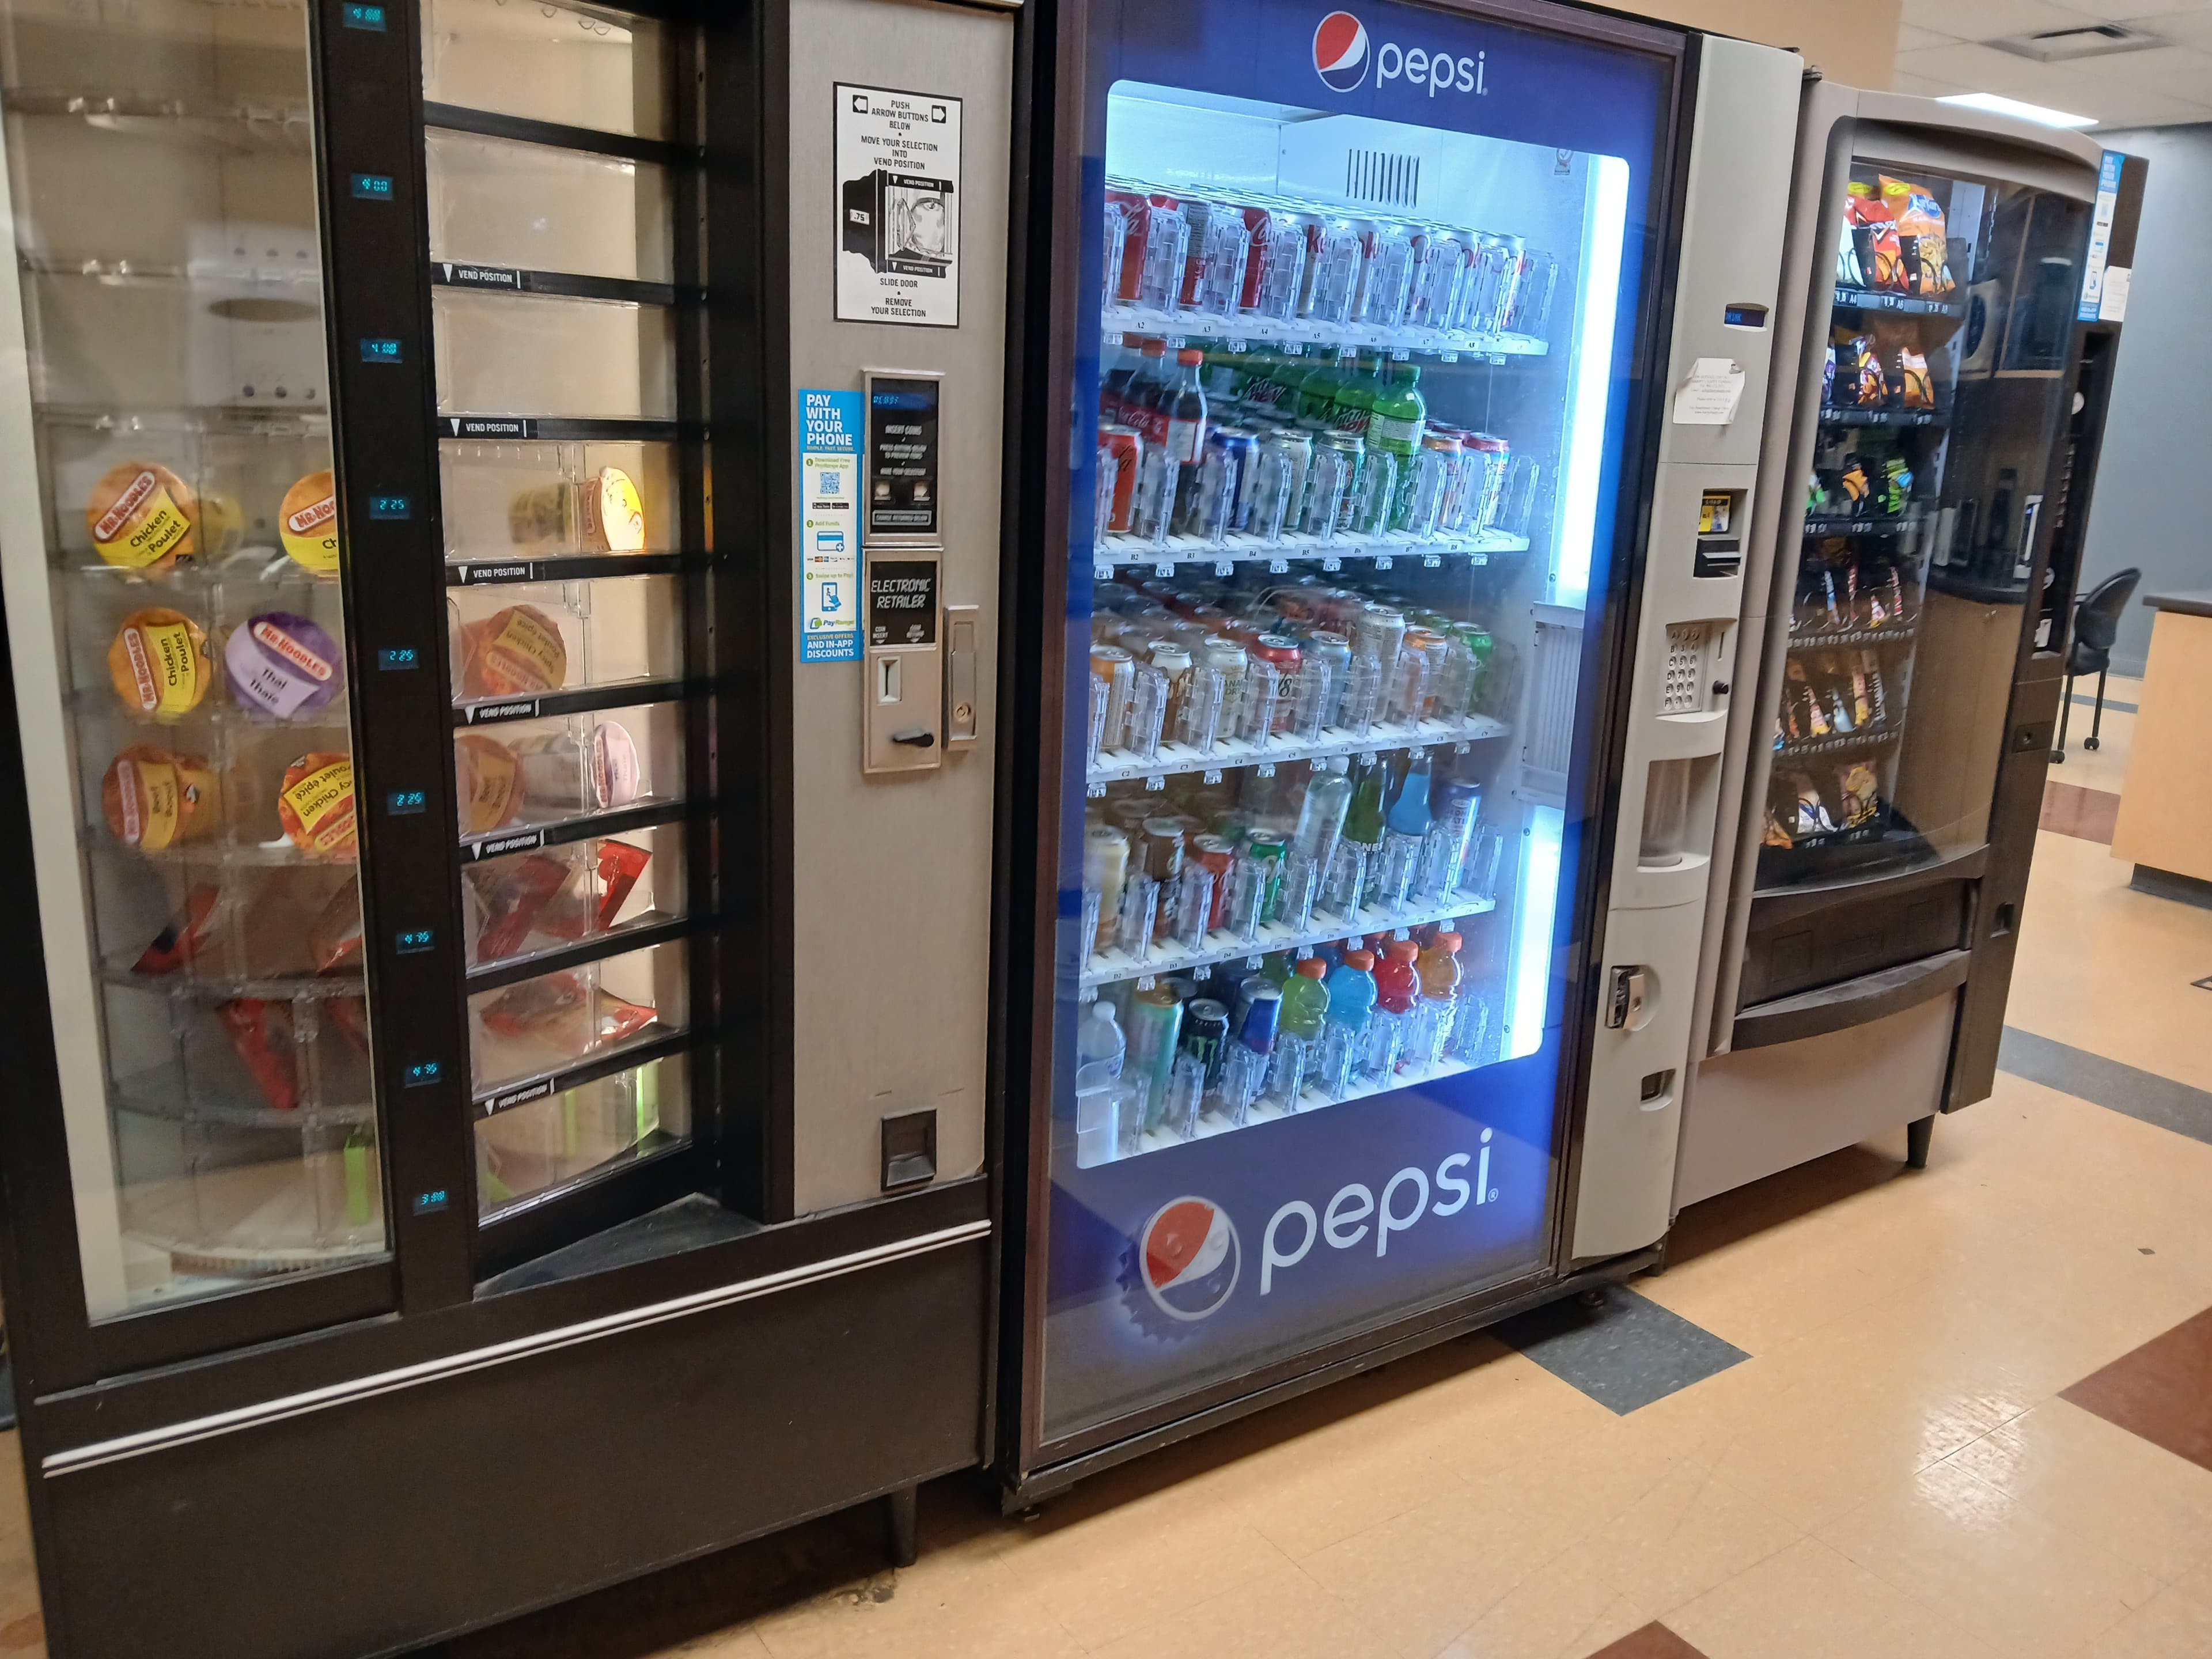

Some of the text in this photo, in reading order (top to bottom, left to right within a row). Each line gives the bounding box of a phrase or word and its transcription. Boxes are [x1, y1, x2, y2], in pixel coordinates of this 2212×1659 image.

[1376, 43, 1485, 97] pepsi
[891, 100, 910, 109] PUSH
[871, 108, 929, 122] ARROW BUTTONS
[889, 121, 911, 130] BELOW
[861, 135, 938, 151] MOVE YOUR SELECTION
[892, 150, 907, 158] INTO
[874, 157, 925, 170] VEND POSITION
[458, 270, 513, 283] VEND POSITION
[880, 278, 918, 288] SLIDE DOOR
[885, 297, 912, 306] REMOVE
[871, 306, 926, 317] YOUR SELECTION
[806, 393, 831, 407] PAY
[806, 407, 841, 420] WITH
[466, 423, 519, 432] VEND POSITION
[806, 420, 843, 433] YOUR
[806, 433, 853, 445] PHONE
[130, 508, 168, 548] Chicken
[148, 520, 181, 554] Poulet
[474, 567, 525, 578] VEND POSITION
[871, 578, 931, 593] ELECTRONIC
[877, 594, 926, 609] RETAILER
[807, 641, 824, 649] AND
[173, 631, 190, 673] Poulet
[807, 649, 854, 658] DISCOUNTS
[160, 638, 177, 687] Chicken
[301, 787, 339, 817] Chicken
[1260, 1127, 1494, 1296] pepsi
